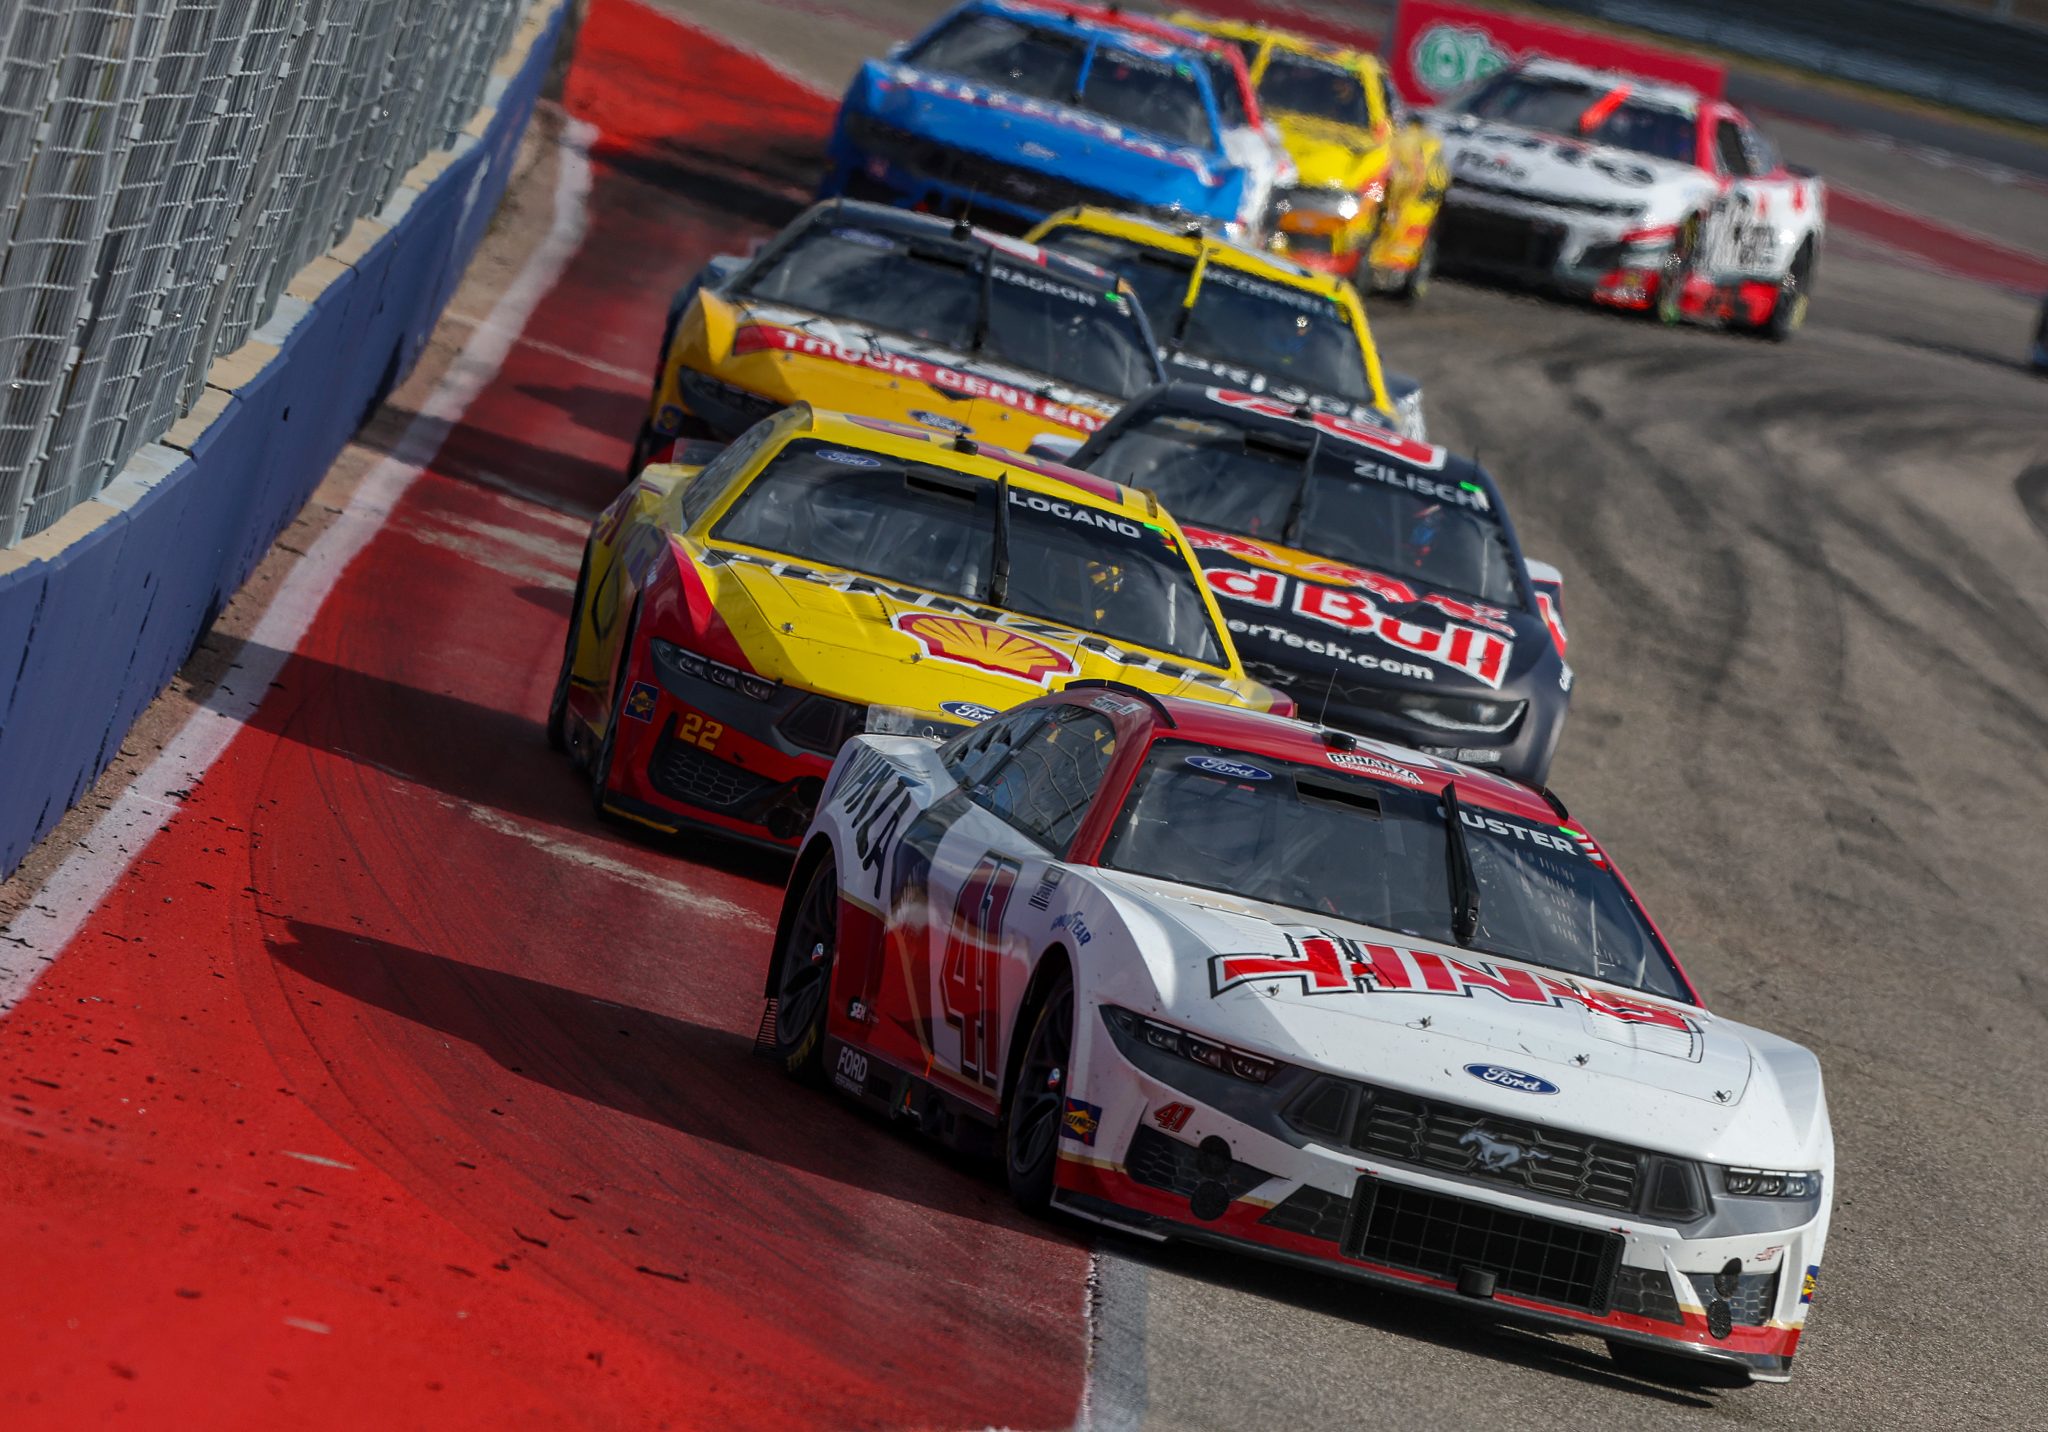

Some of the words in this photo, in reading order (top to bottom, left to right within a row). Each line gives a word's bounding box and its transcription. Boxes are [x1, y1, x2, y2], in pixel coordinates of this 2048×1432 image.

[776, 328, 921, 378] TRUCK
[1353, 459, 1490, 511] ZILISCH
[1009, 491, 1142, 538] LOGANO
[1292, 579, 1513, 690] Bull
[680, 712, 724, 752] 22
[1327, 752, 1424, 785] BONANZA
[939, 848, 1024, 1090] 41
[837, 1046, 868, 1082] FORD
[1153, 1101, 1196, 1133] 41
